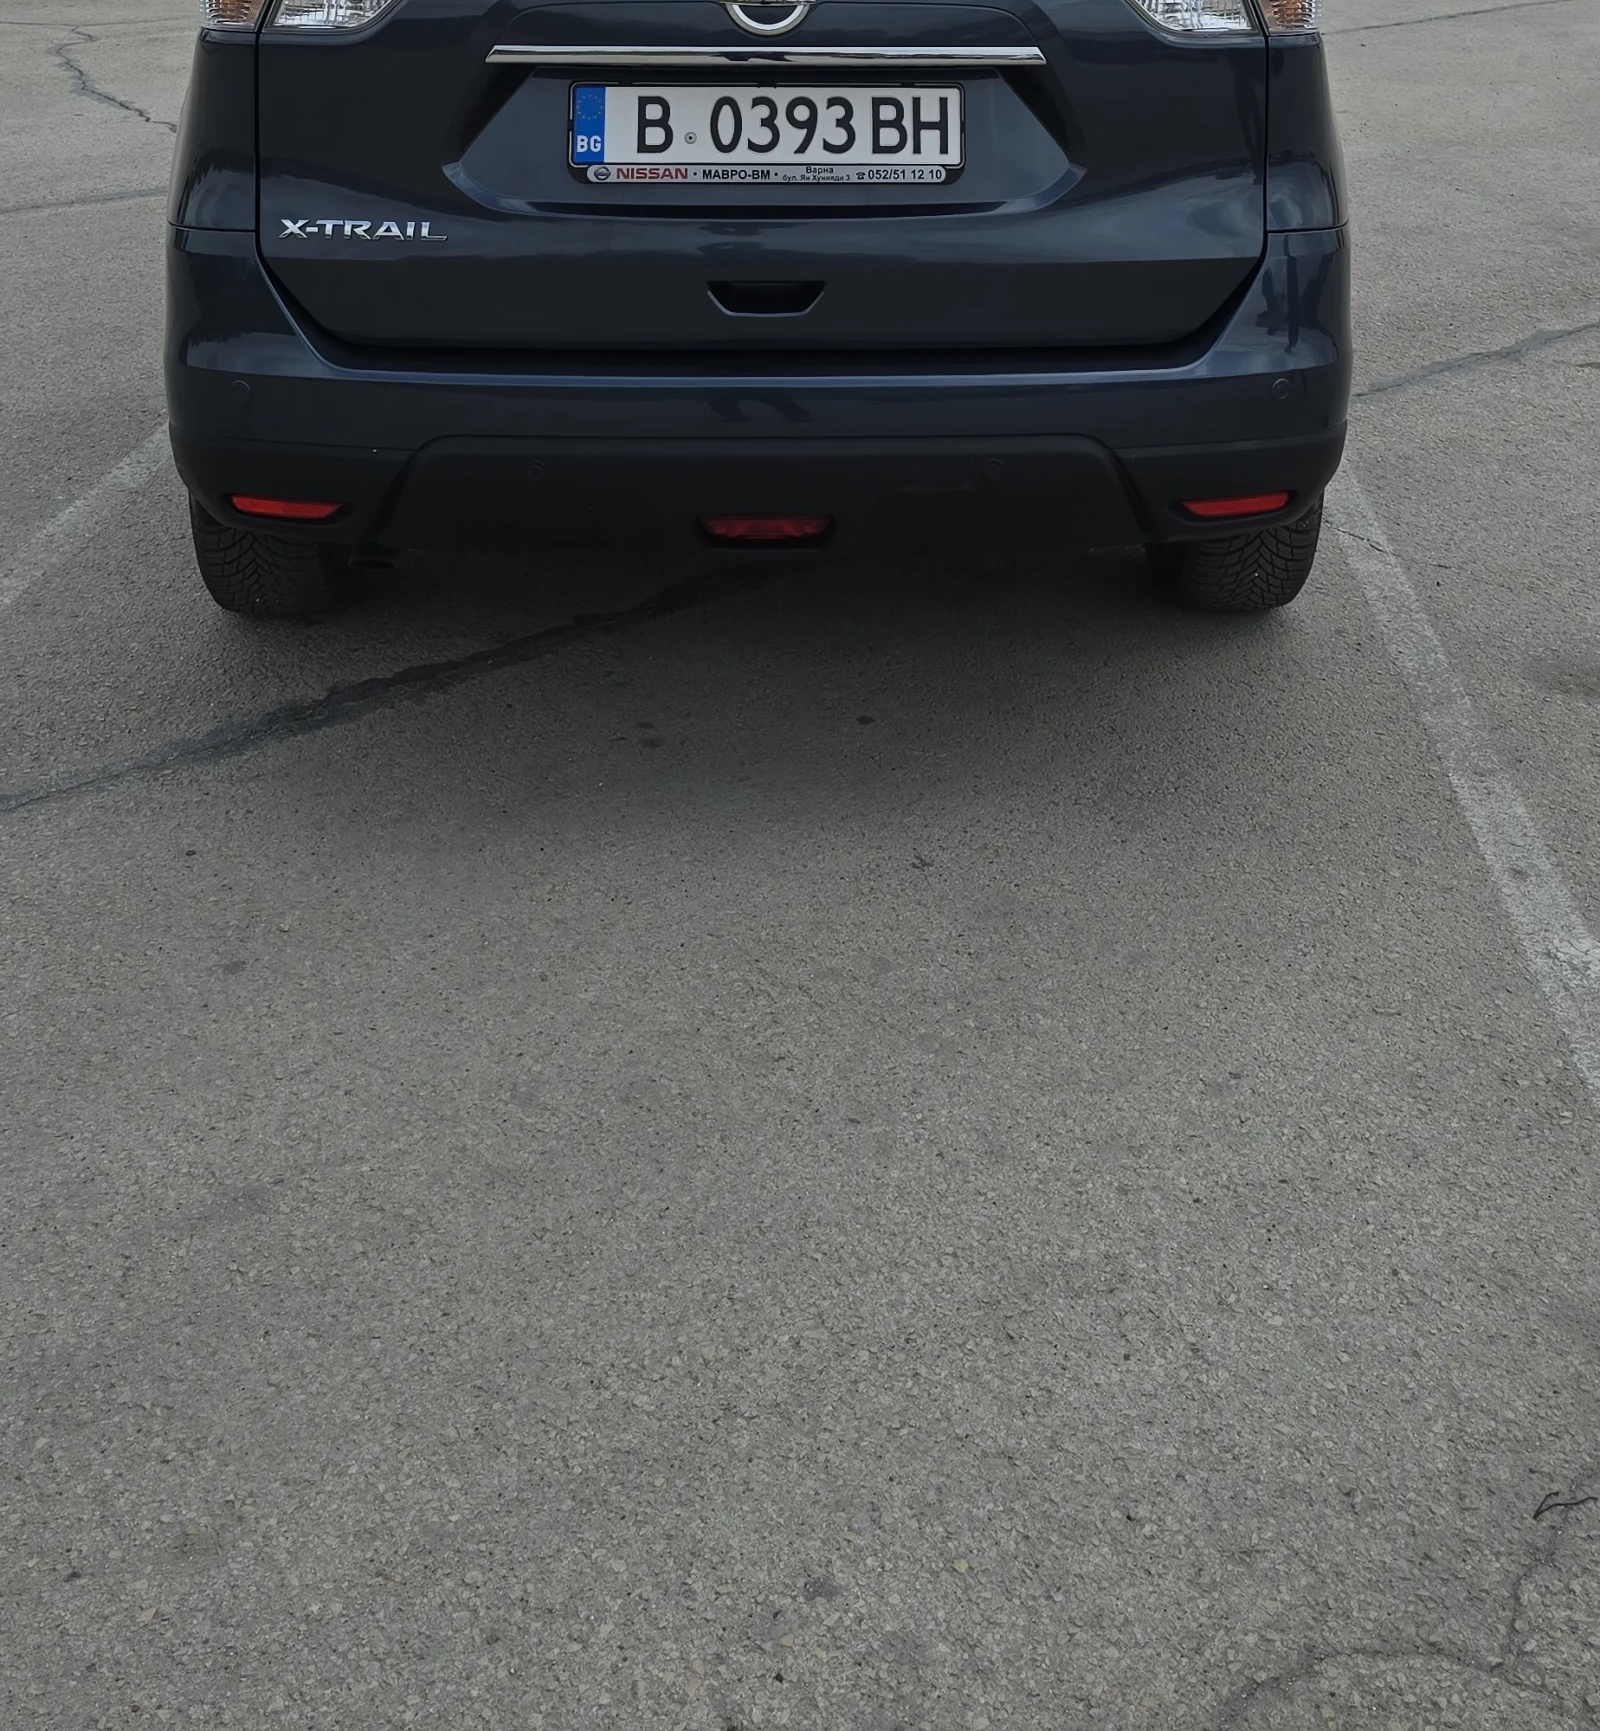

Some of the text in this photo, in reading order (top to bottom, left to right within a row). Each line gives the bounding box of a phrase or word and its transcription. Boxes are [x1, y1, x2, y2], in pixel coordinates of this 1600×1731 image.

[636, 96, 674, 154] B
[710, 96, 856, 155] 0393
[577, 135, 601, 152] BG
[616, 168, 688, 179] NISSAN
[806, 166, 834, 175] Варна
[868, 169, 942, 180] 052/51 12 10
[278, 219, 448, 240] X-TRAIL
